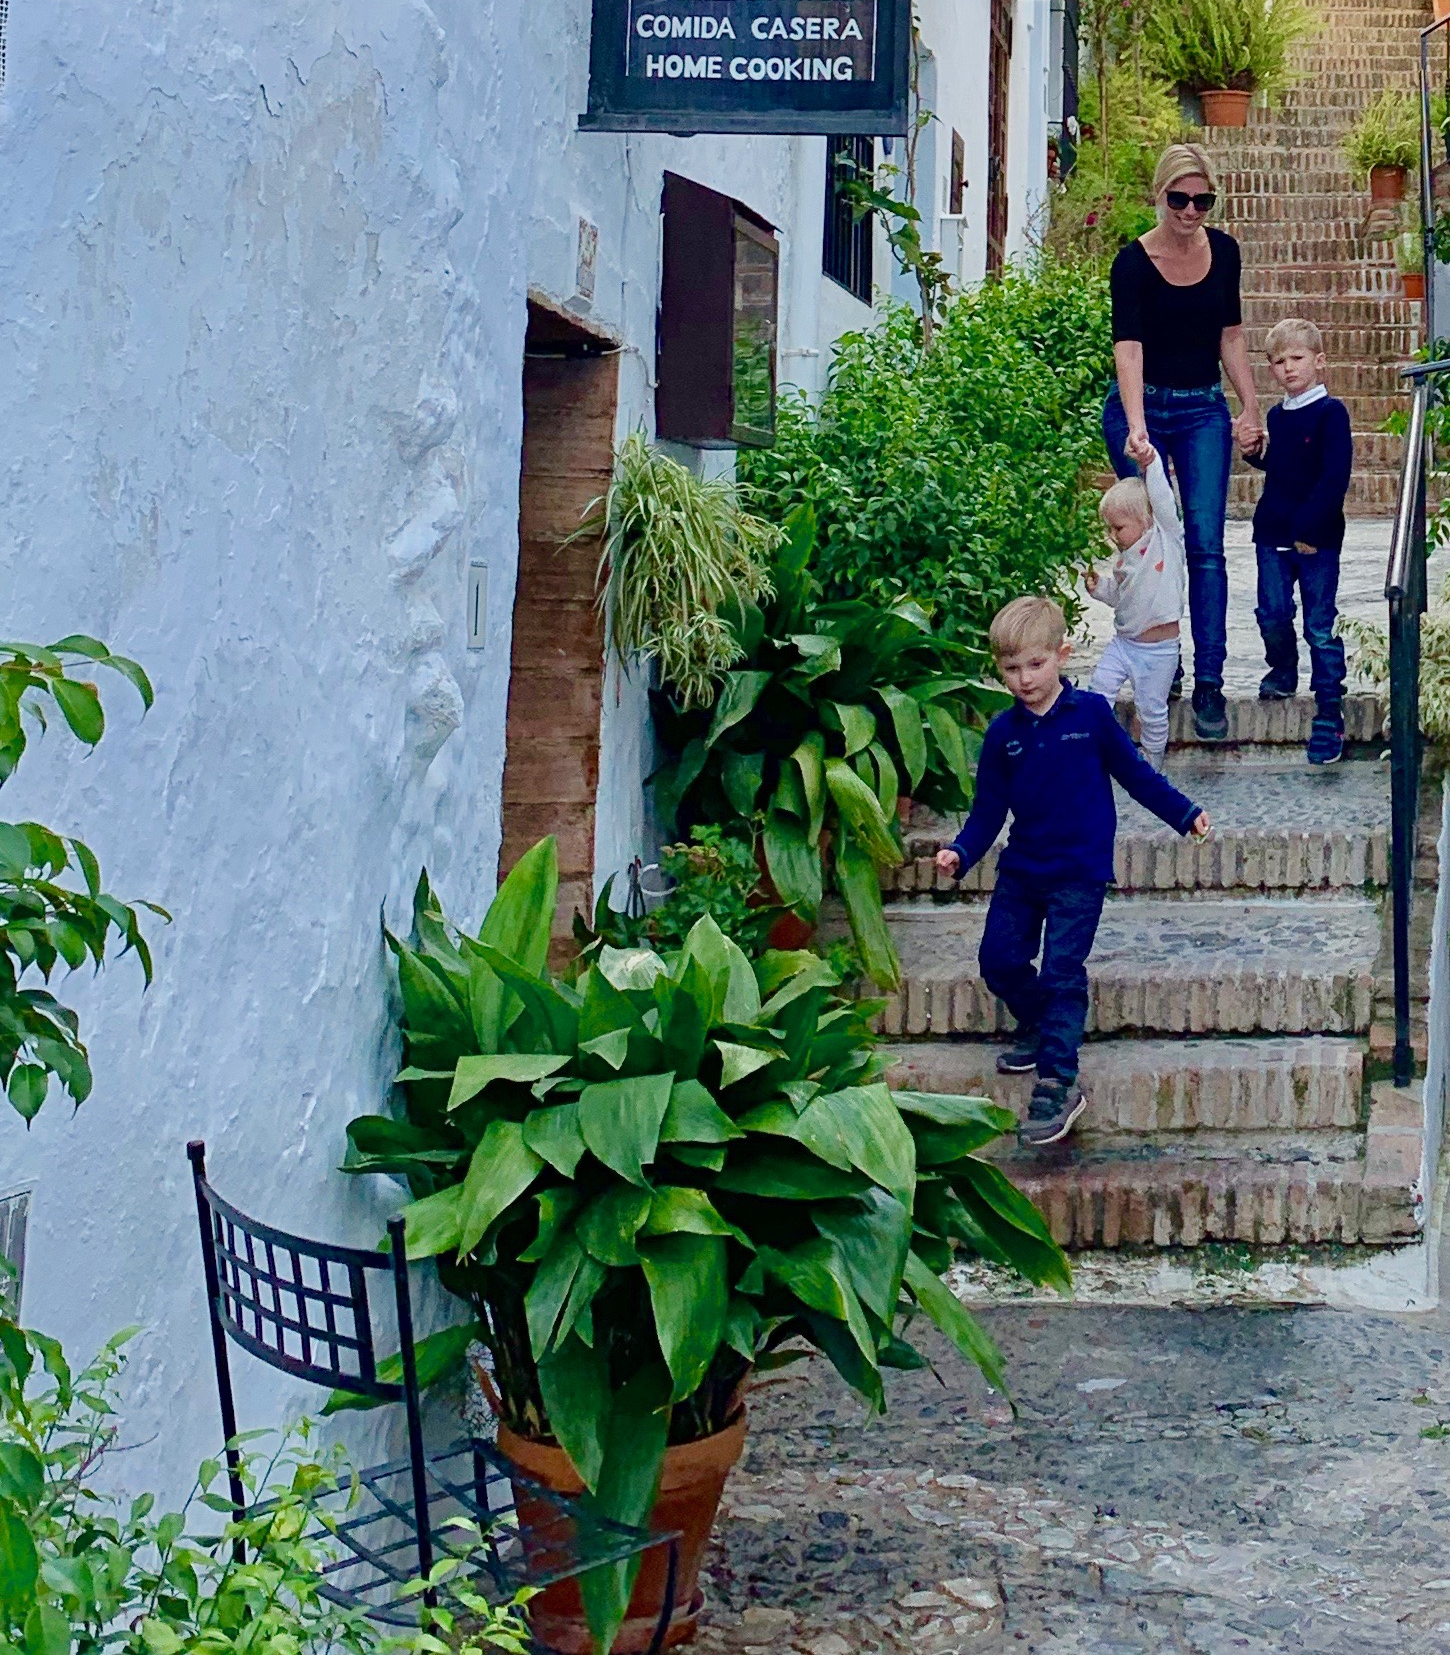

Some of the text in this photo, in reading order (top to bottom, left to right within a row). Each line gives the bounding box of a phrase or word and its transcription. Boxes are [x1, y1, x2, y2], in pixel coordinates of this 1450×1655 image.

[636, 14, 863, 40] COMIDA CASERA
[646, 54, 853, 81] HOME COOKING
